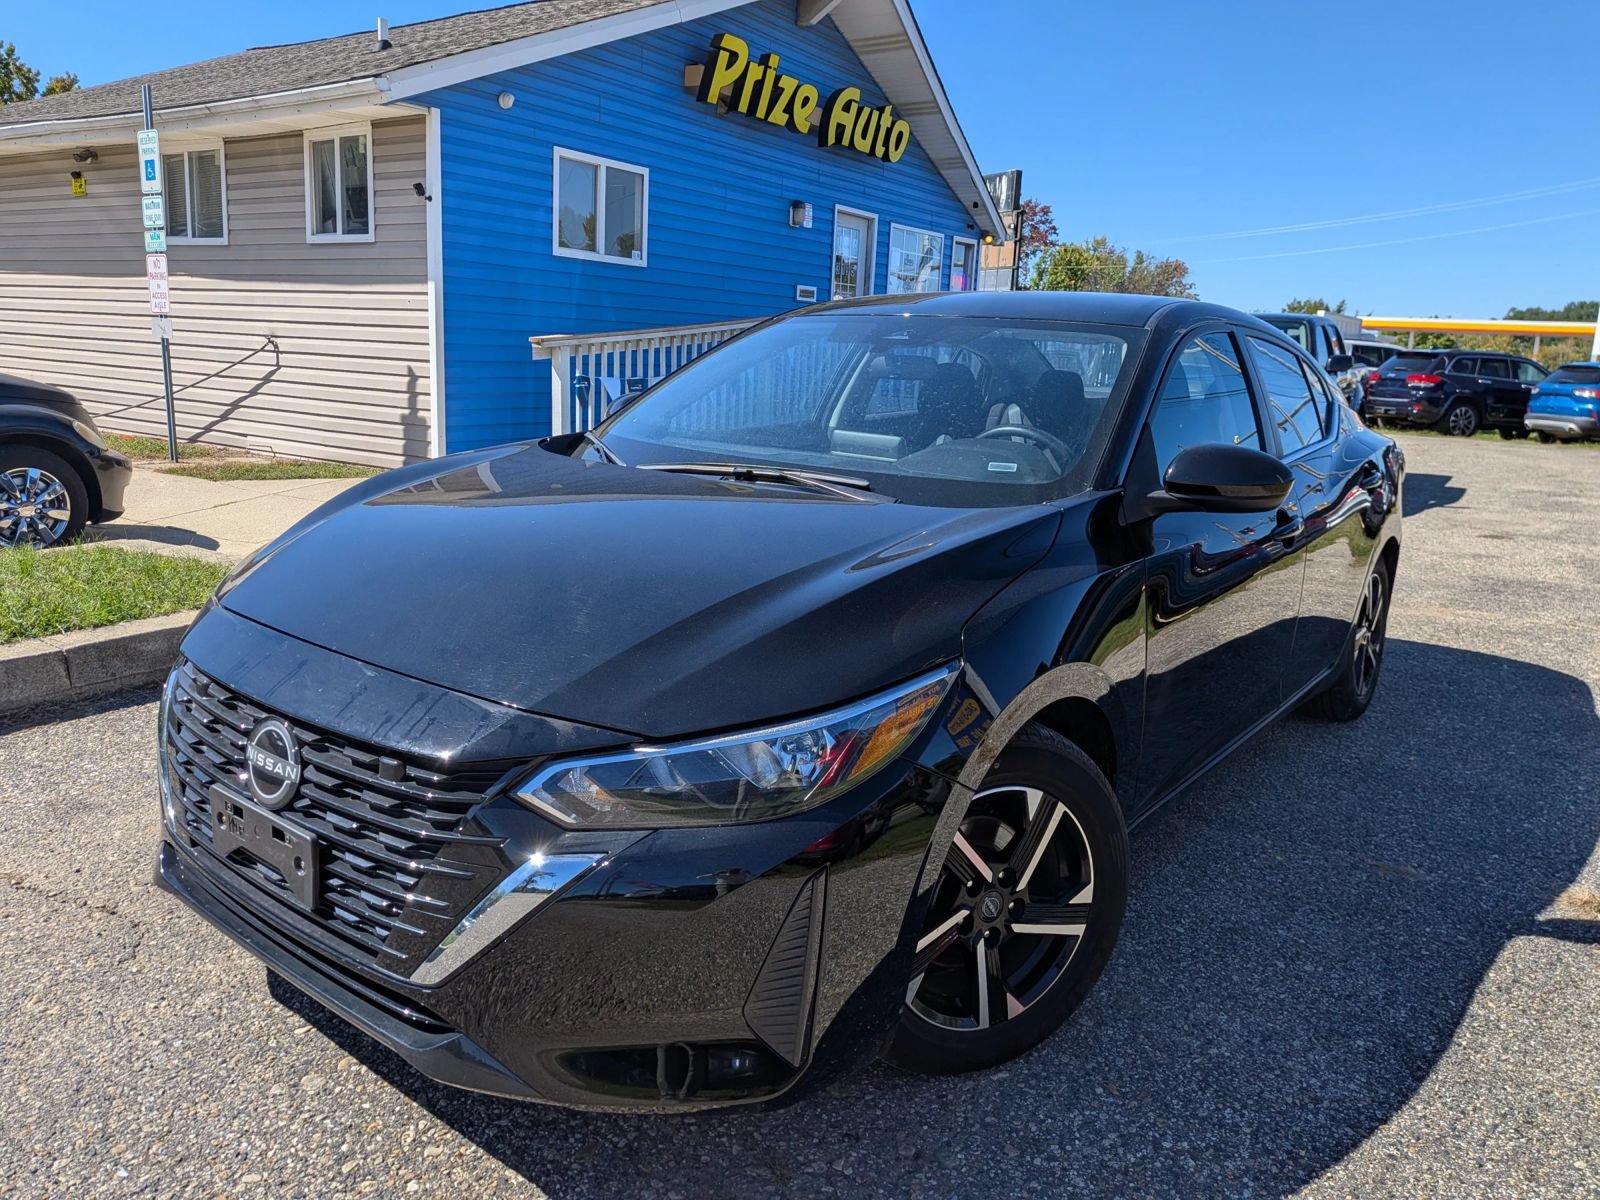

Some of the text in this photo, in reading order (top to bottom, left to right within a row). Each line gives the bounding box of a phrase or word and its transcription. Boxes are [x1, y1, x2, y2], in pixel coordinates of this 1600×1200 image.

[705, 33, 911, 163] Prize Auto
[150, 232, 161, 241] VAN
[153, 259, 161, 269] NO
[149, 272, 167, 281] PARKING
[152, 291, 167, 300] ACCESS
[154, 302, 167, 310] AISLE
[247, 742, 297, 780] NISSAN
